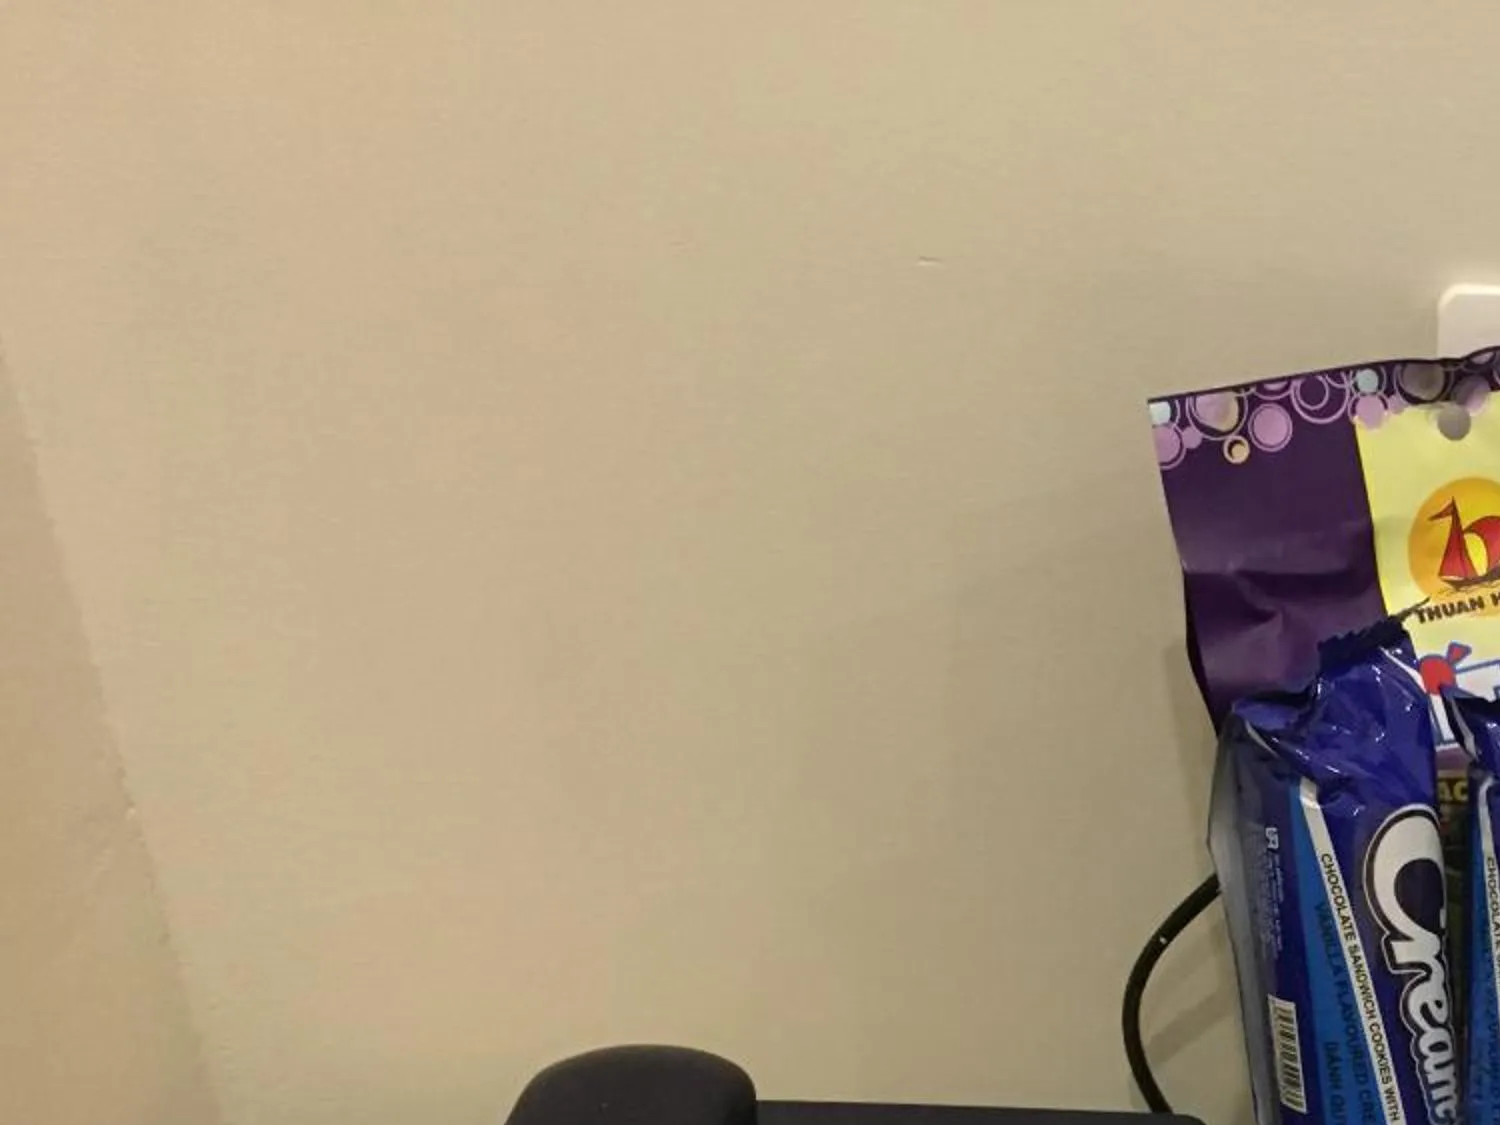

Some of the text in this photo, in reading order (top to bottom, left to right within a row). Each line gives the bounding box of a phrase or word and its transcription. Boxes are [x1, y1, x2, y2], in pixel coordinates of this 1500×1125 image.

[1416, 594, 1486, 624] THUAN
[1320, 852, 1401, 1122] CHOCOLATE SANDWICH COOKIES WITH
